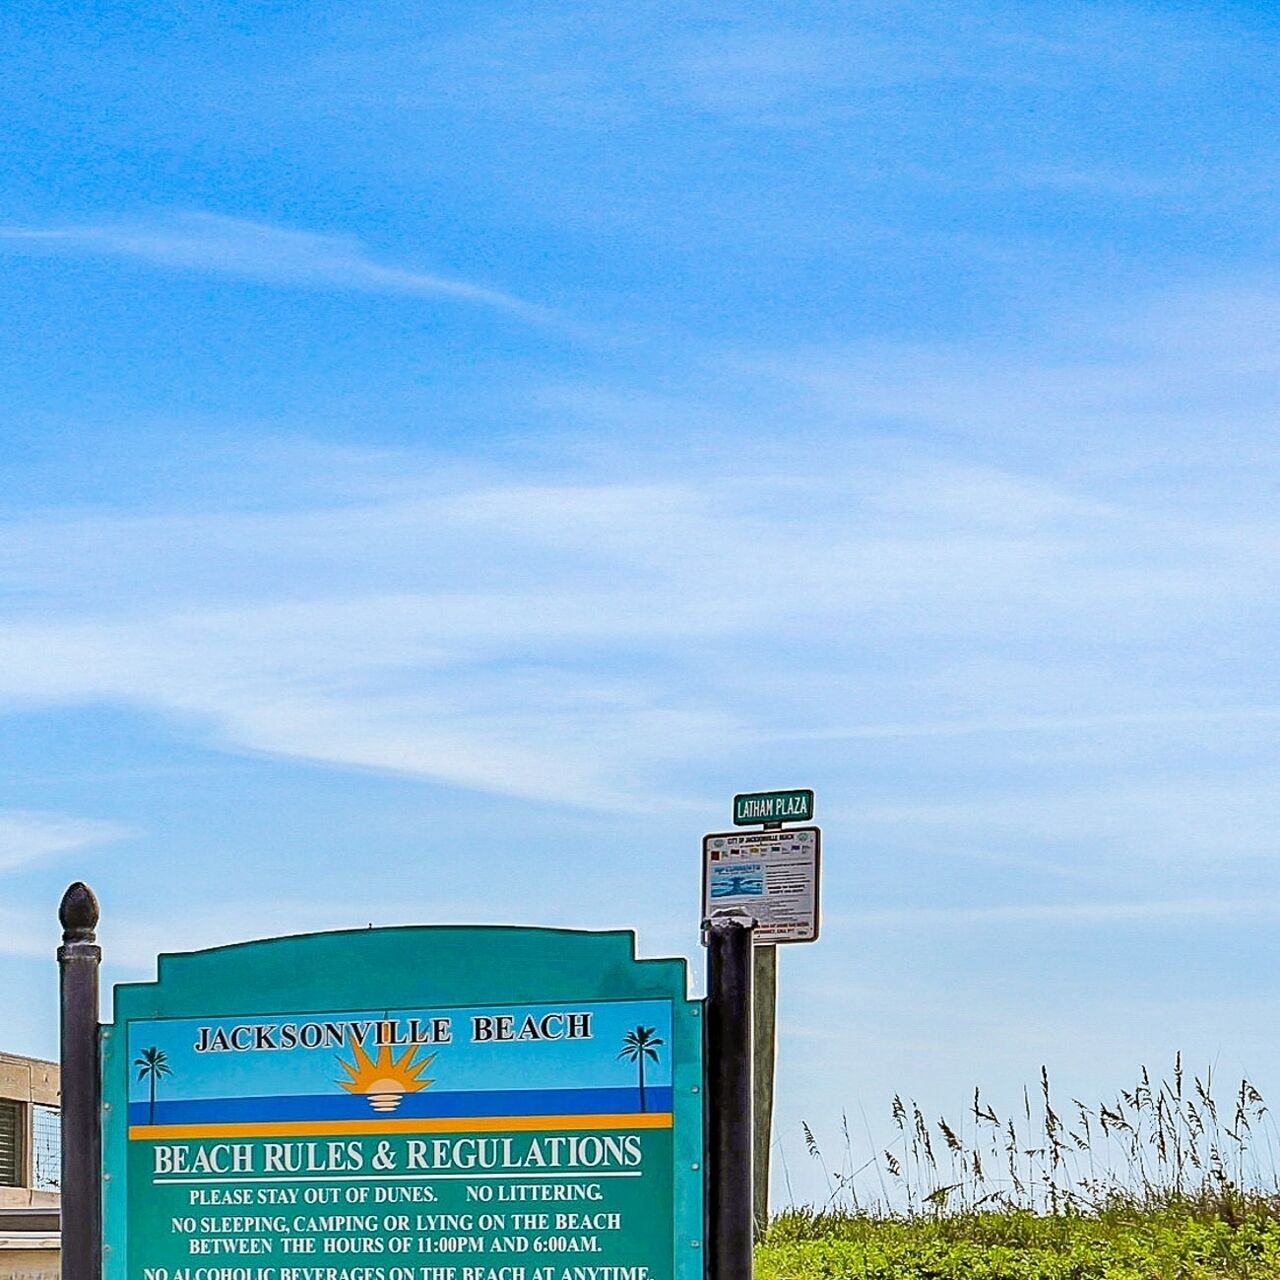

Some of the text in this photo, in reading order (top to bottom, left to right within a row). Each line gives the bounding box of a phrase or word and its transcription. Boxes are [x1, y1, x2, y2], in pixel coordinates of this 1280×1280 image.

[738, 797, 807, 818] LATHAM PLAZA
[194, 1013, 592, 1052] JACKSONVILLE BEACH
[153, 1135, 643, 1174] BEACH RULES & REGULATIONS
[190, 1184, 603, 1205] PLEASE STAY OUT OF DUNES. NO LITTERING.
[172, 1214, 621, 1233] NO SLEEPING, CAMPING OR LYING ON THE BEACH
[189, 1237, 602, 1254] BETWEEN THE HOURS OF 11:00PM AND 6:00AM.
